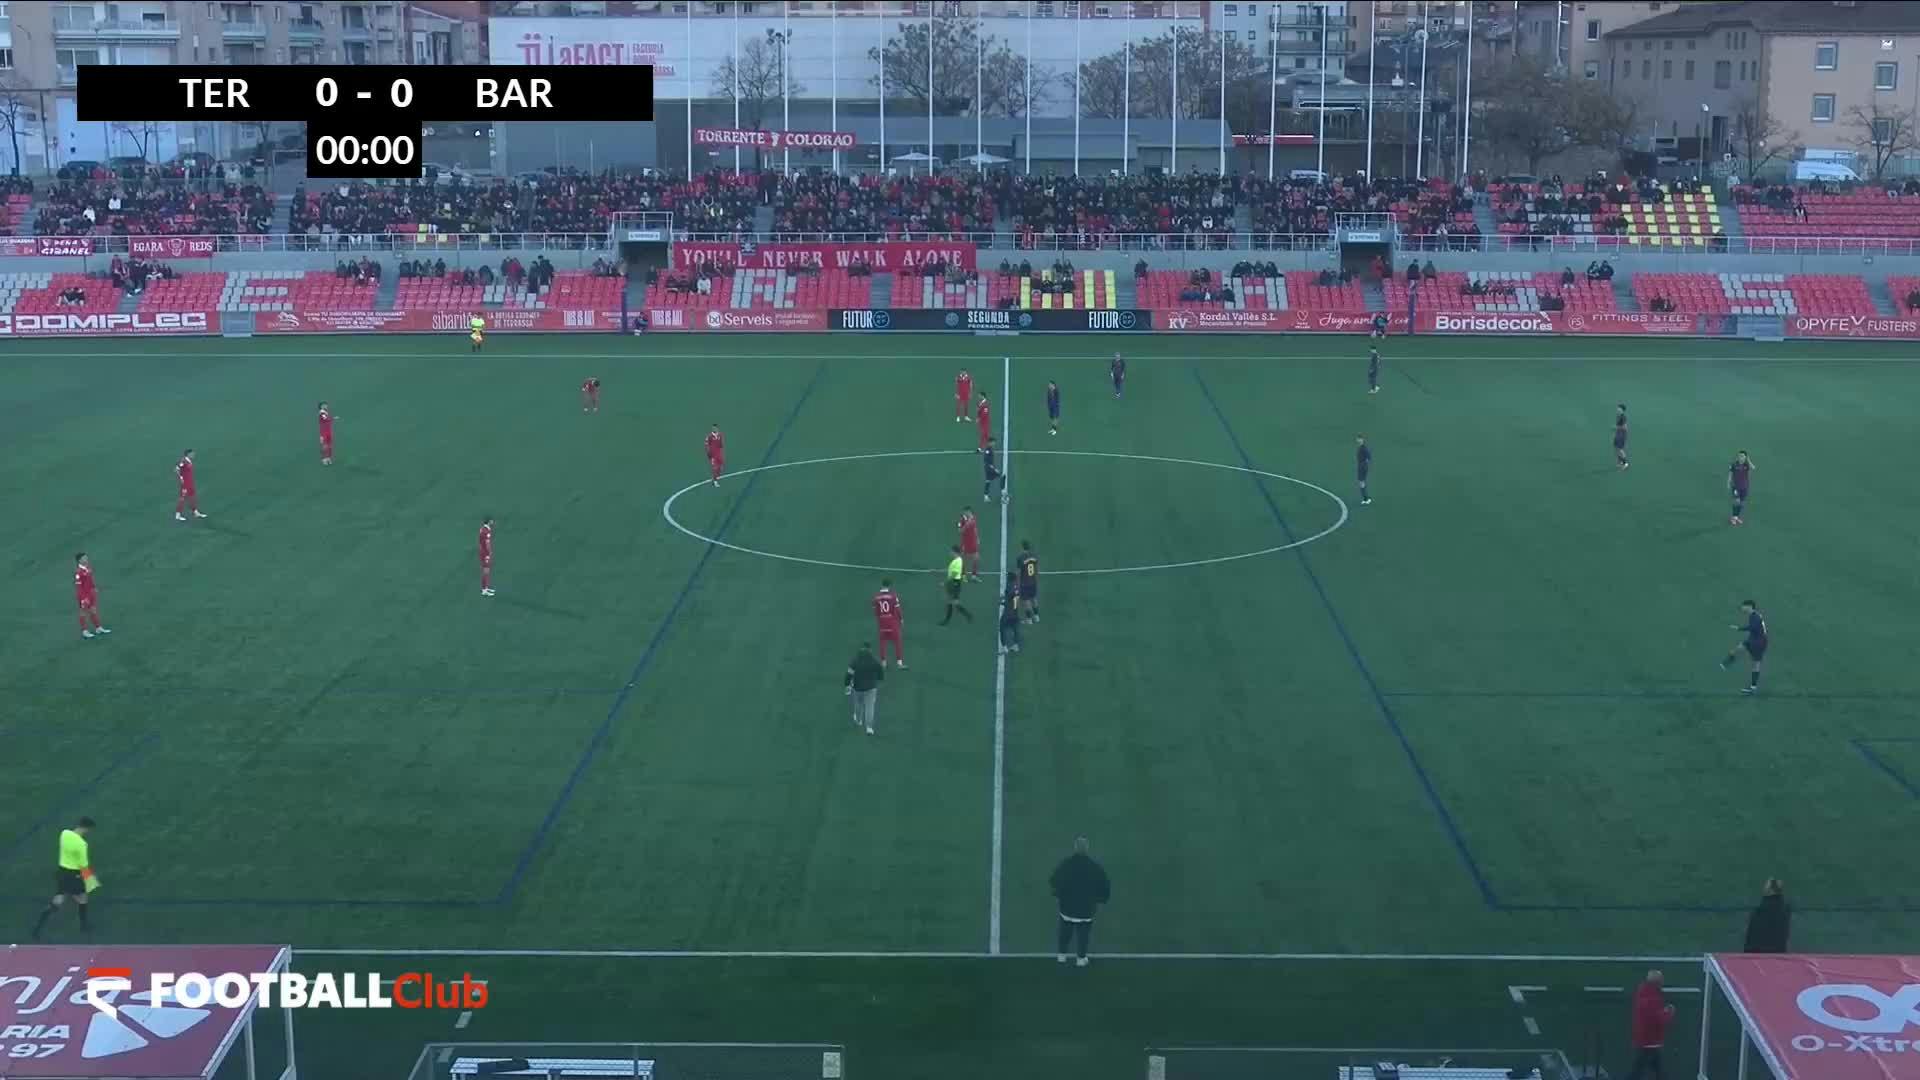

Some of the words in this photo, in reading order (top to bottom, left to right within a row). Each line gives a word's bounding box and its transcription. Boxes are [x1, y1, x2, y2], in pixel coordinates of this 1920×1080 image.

[697, 130, 765, 144] TORRENTE
[785, 134, 854, 147] COLORAO
[133, 241, 164, 252] EGARA
[190, 241, 214, 252] REDS
[763, 251, 824, 268] NEVER
[835, 250, 886, 267] WALK
[904, 250, 963, 267] ALONE
[16, 312, 207, 330] DOMIPLEC
[724, 312, 773, 326] Serveis
[842, 310, 873, 328] FUTUR
[967, 310, 1010, 324] SEGUNDA
[1088, 311, 1119, 329] FUTUR
[1200, 312, 1230, 321] Kordal
[1592, 313, 1648, 322] FITTINGS
[1867, 320, 1917, 332] FUSTERS
[1027, 563, 1035, 576] 8
[879, 600, 890, 613] 10
